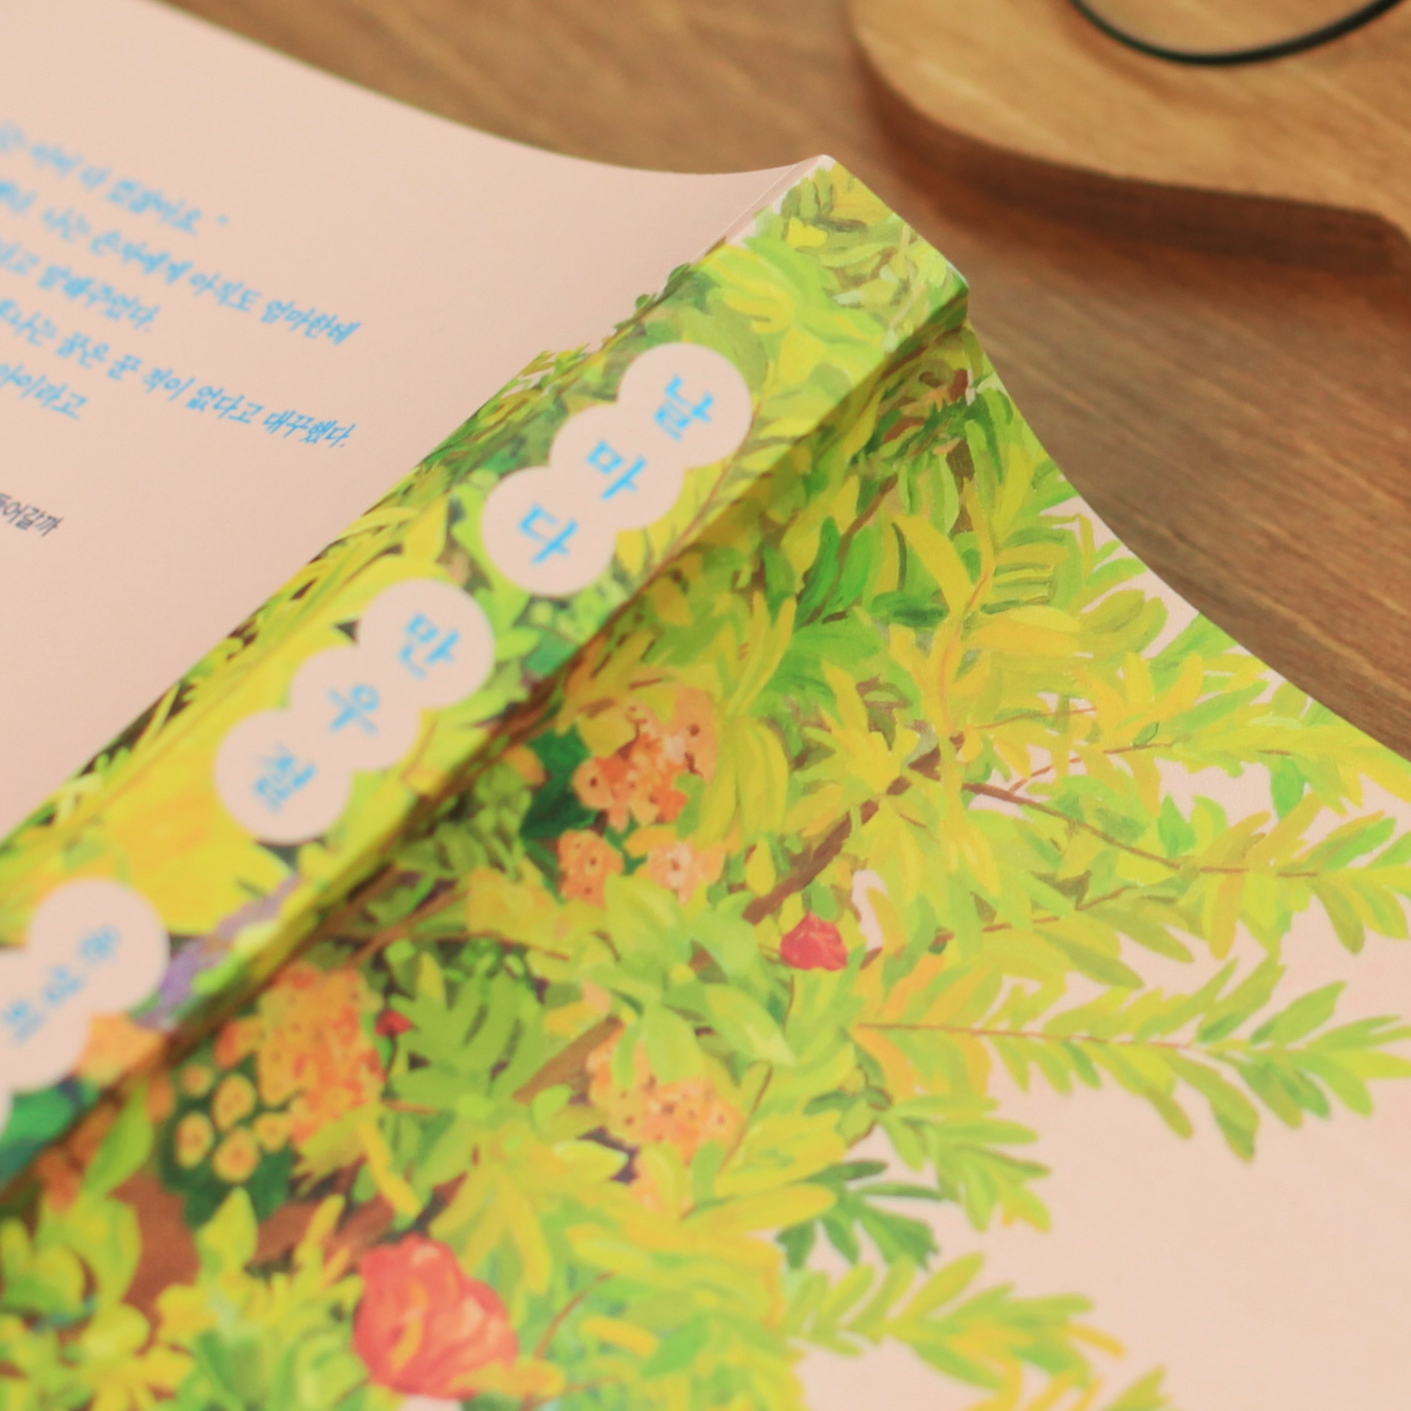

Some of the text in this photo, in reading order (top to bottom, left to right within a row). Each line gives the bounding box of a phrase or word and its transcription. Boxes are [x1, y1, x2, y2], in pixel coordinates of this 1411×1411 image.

[189, 272, 262, 311] 아직도
[260, 300, 362, 345] 엄마한테
[185, 384, 265, 425] 없다고
[262, 409, 358, 448] 대꾸했다.
[250, 374, 717, 814] 날마다 만우절
